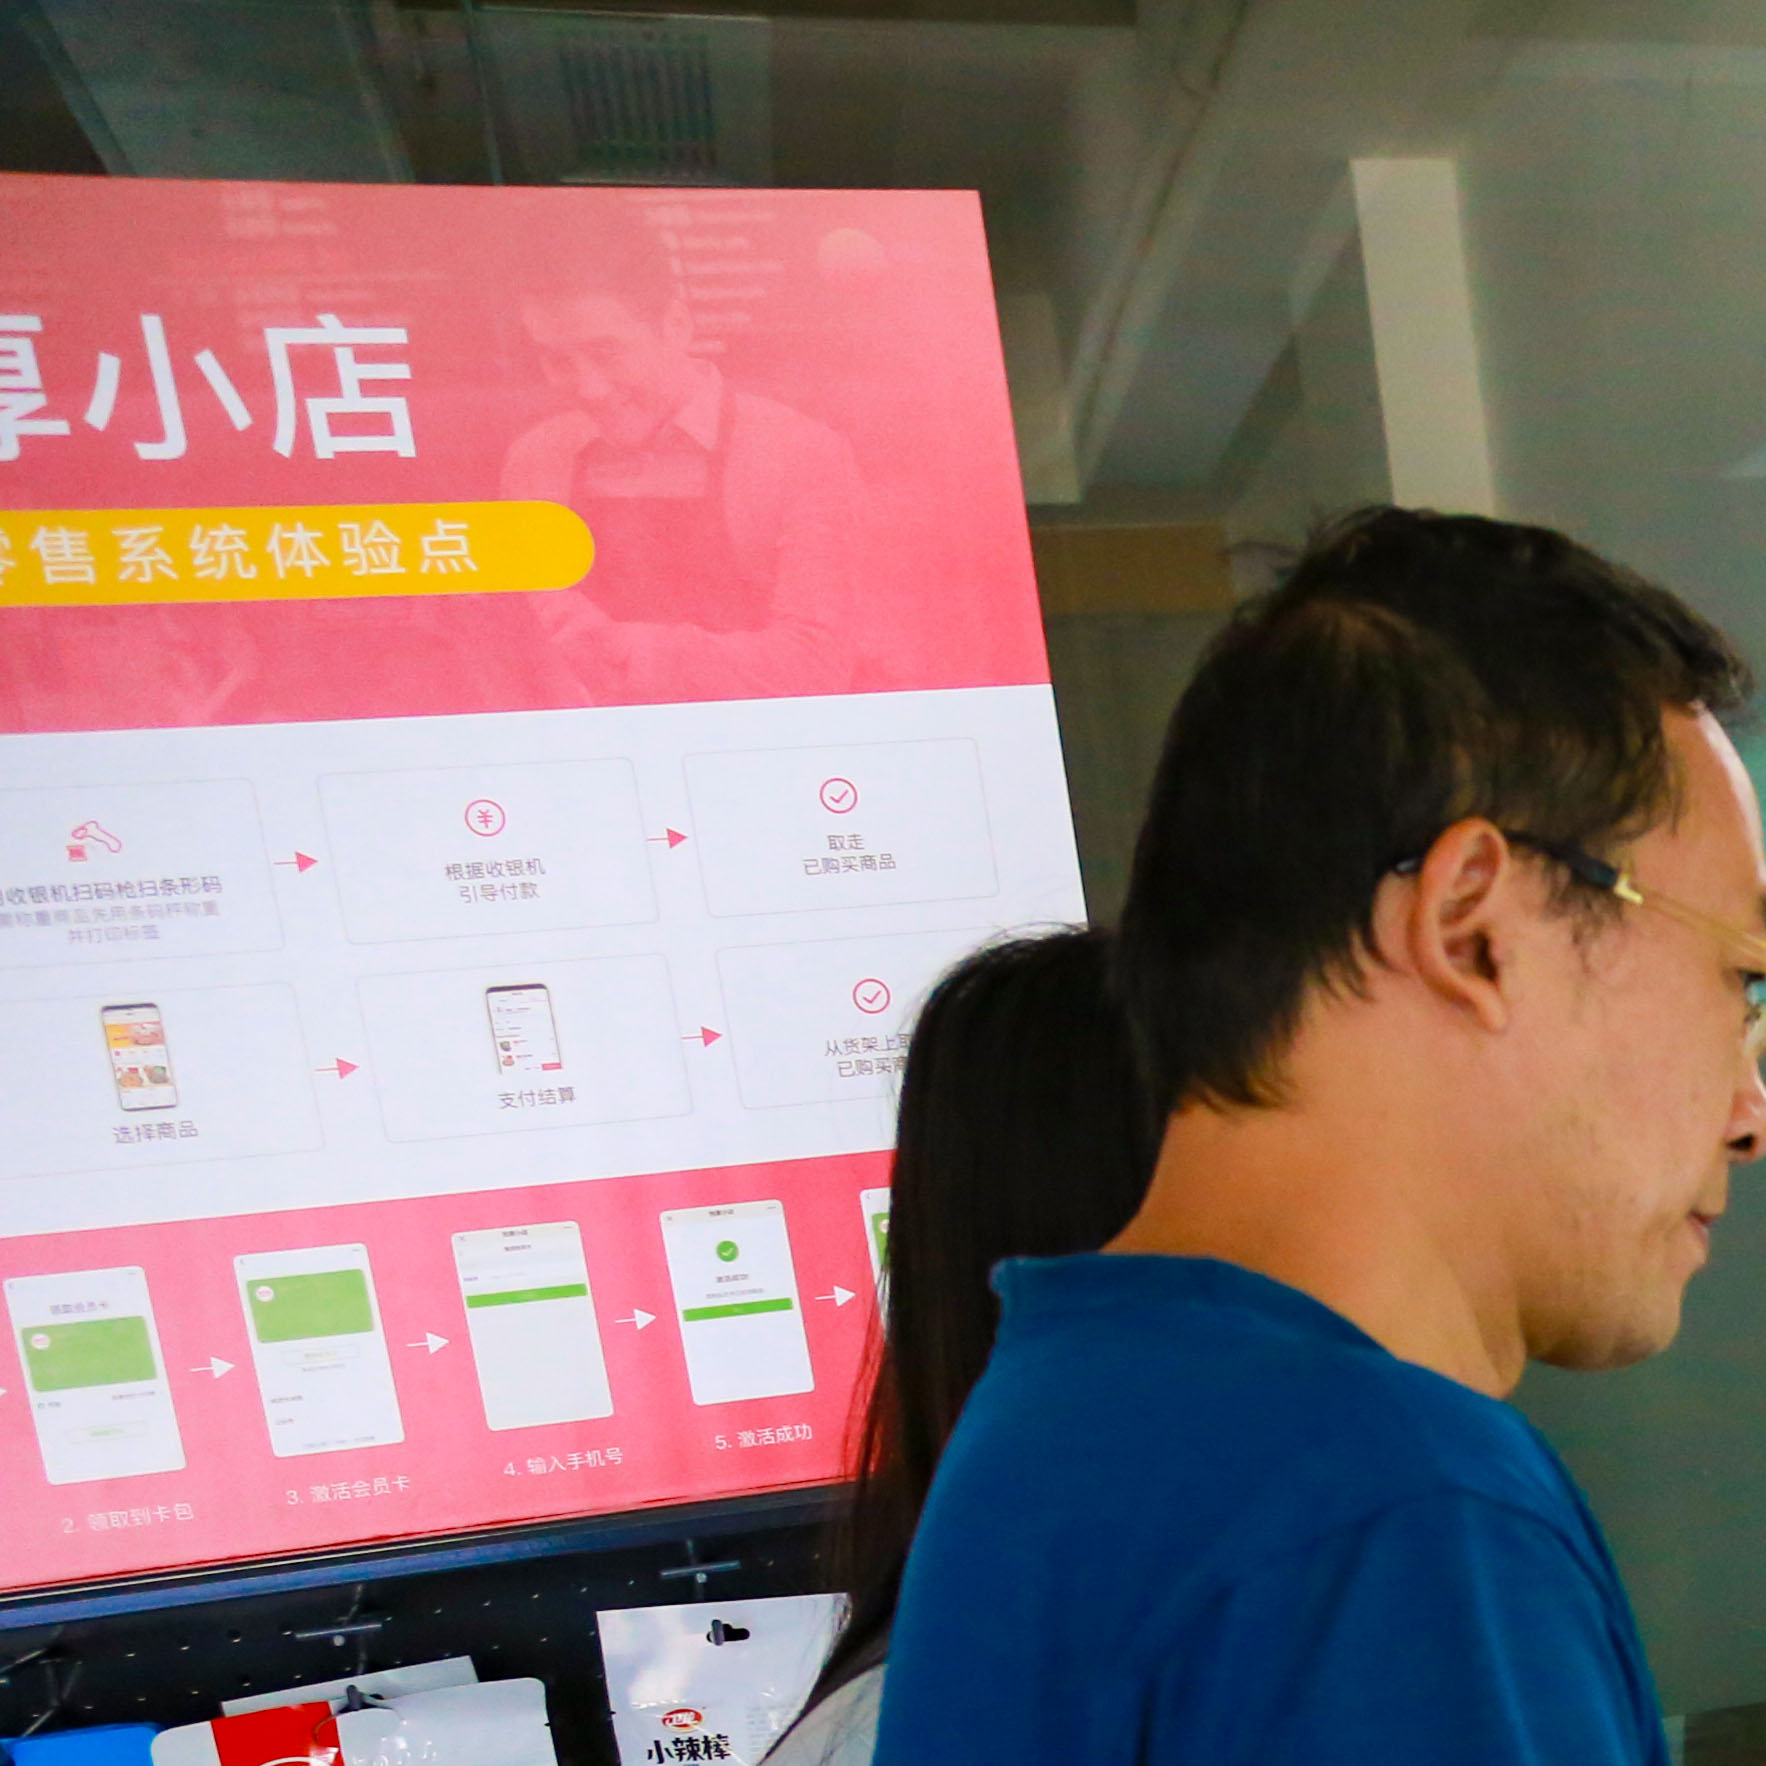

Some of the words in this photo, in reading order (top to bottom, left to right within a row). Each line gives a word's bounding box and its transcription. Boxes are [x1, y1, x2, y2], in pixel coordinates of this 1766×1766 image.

[0, 518, 478, 585] 售系统体验点
[827, 834, 864, 852] 取走
[444, 858, 546, 880] 根据收银机
[803, 853, 896, 876] 已购买商品
[0, 876, 222, 906] 收银机扫码枪扫条形码
[459, 882, 540, 904] 引导付款
[499, 1086, 576, 1111] 支付结算
[112, 1119, 199, 1145] 选择商品
[737, 1424, 813, 1448] 激活成功
[527, 1447, 623, 1476] 输入手机号
[310, 1475, 411, 1504] 激活会员卡
[87, 1502, 195, 1533] 领取到卡包
[647, 1733, 731, 1765] 小辣棒
